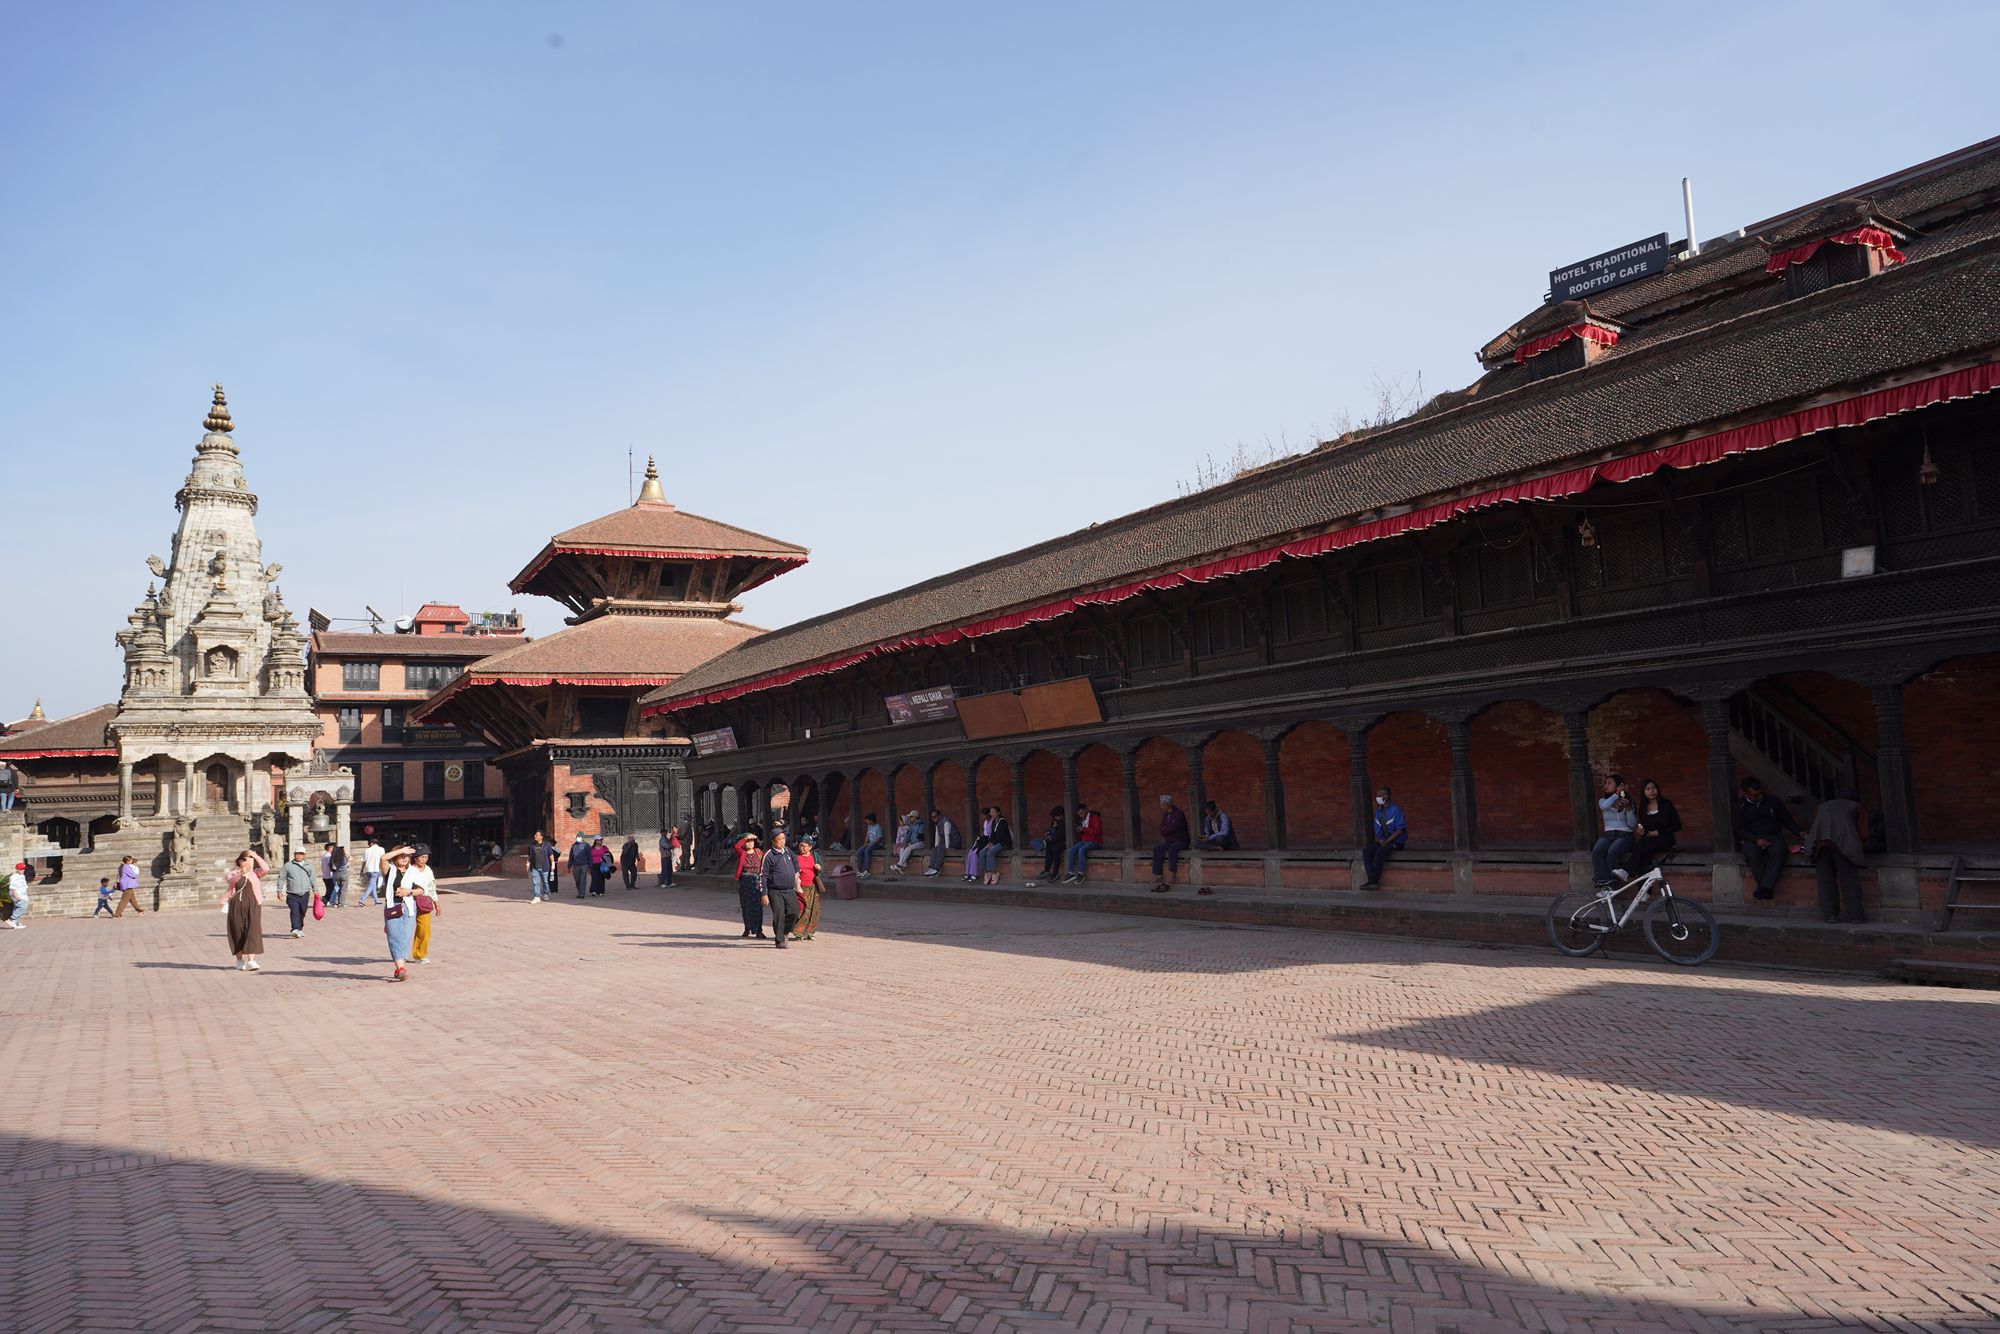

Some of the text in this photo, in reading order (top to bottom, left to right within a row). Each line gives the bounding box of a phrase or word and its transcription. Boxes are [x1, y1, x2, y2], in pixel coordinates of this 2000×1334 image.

[1554, 240, 1662, 284] HOTEL TRADITIONAL
[1569, 261, 1648, 295] ROOFTOP CAFE
[912, 693, 929, 705] NEPALI
[928, 691, 943, 702] GHAR
